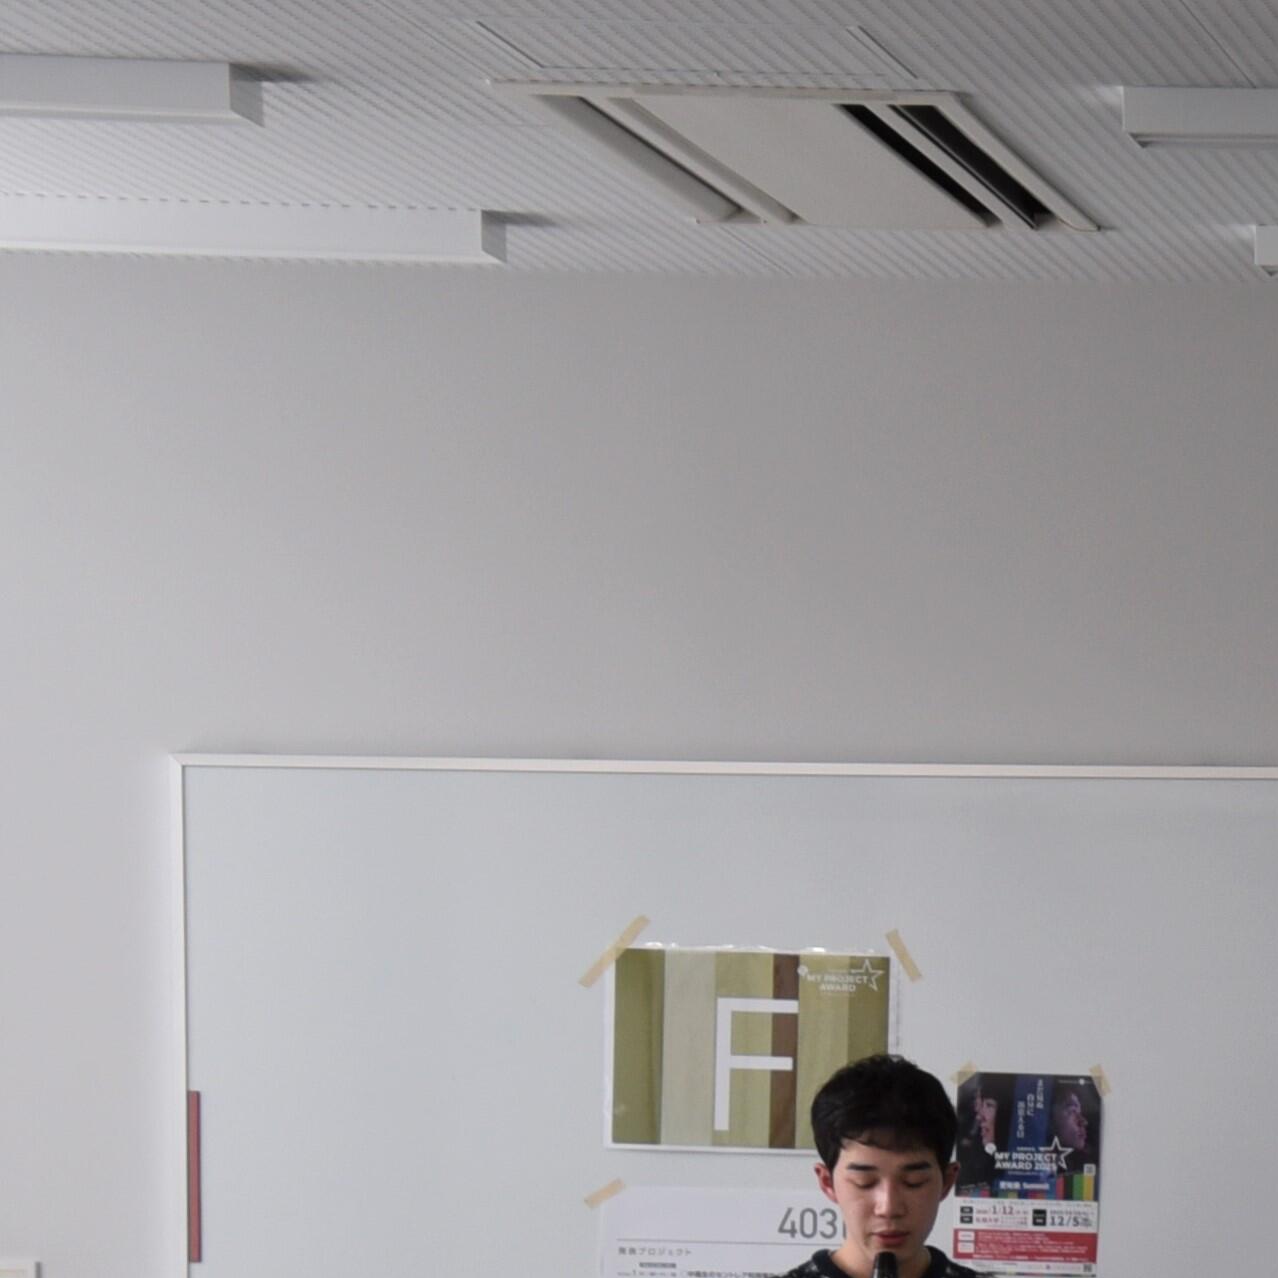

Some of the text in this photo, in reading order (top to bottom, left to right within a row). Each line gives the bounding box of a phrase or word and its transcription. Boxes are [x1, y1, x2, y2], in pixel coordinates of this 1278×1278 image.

[714, 997, 799, 1131] F
[994, 1152, 1057, 1162] MY PROJECT
[994, 1160, 1033, 1170] AWARD
[778, 1207, 847, 1239] 403
